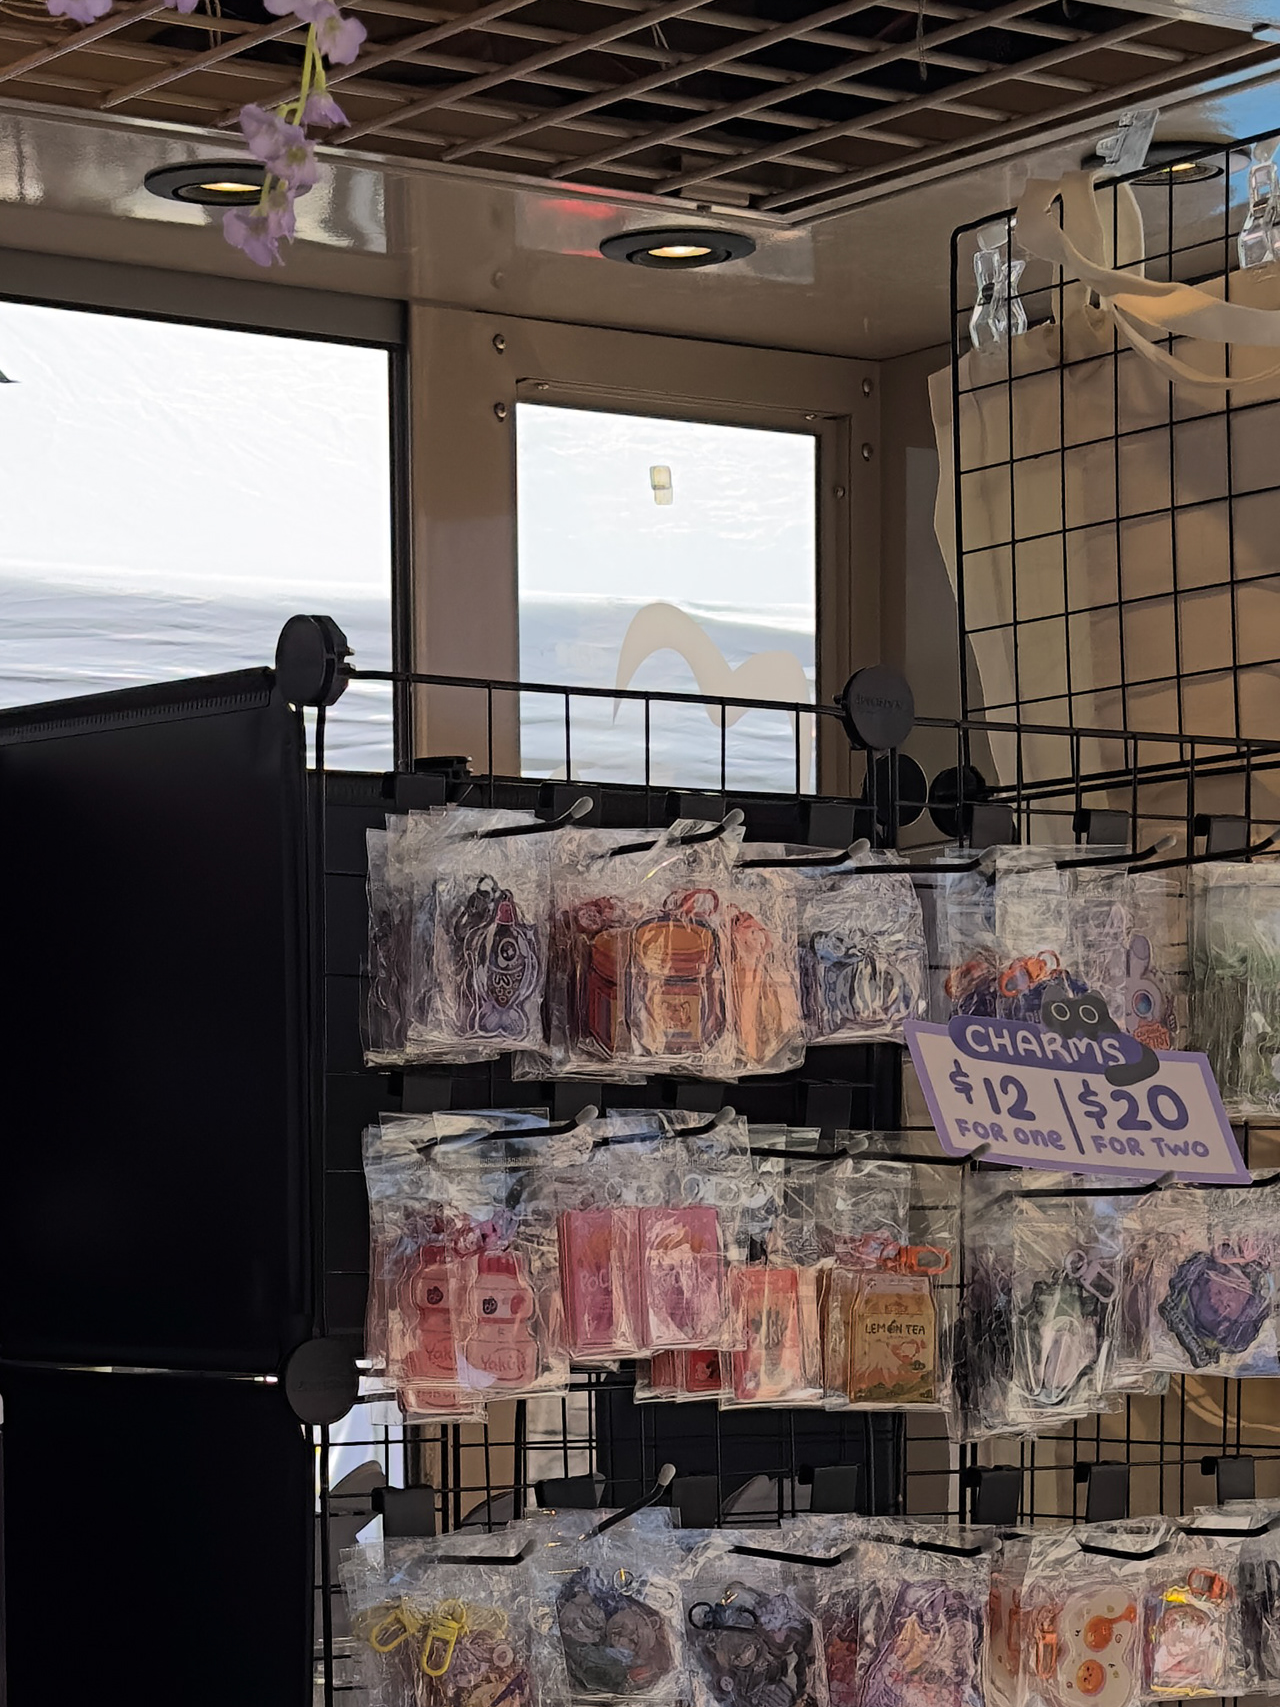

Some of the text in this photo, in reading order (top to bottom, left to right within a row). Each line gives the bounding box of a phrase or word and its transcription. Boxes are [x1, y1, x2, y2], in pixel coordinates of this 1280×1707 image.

[965, 1024, 1125, 1066] CHARMS
[949, 1059, 1036, 1122] $12
[1078, 1079, 1189, 1131] $20
[955, 1118, 1008, 1143] FOR
[1090, 1135, 1210, 1159] FOR TWO
[905, 1324, 926, 1335] TEA
